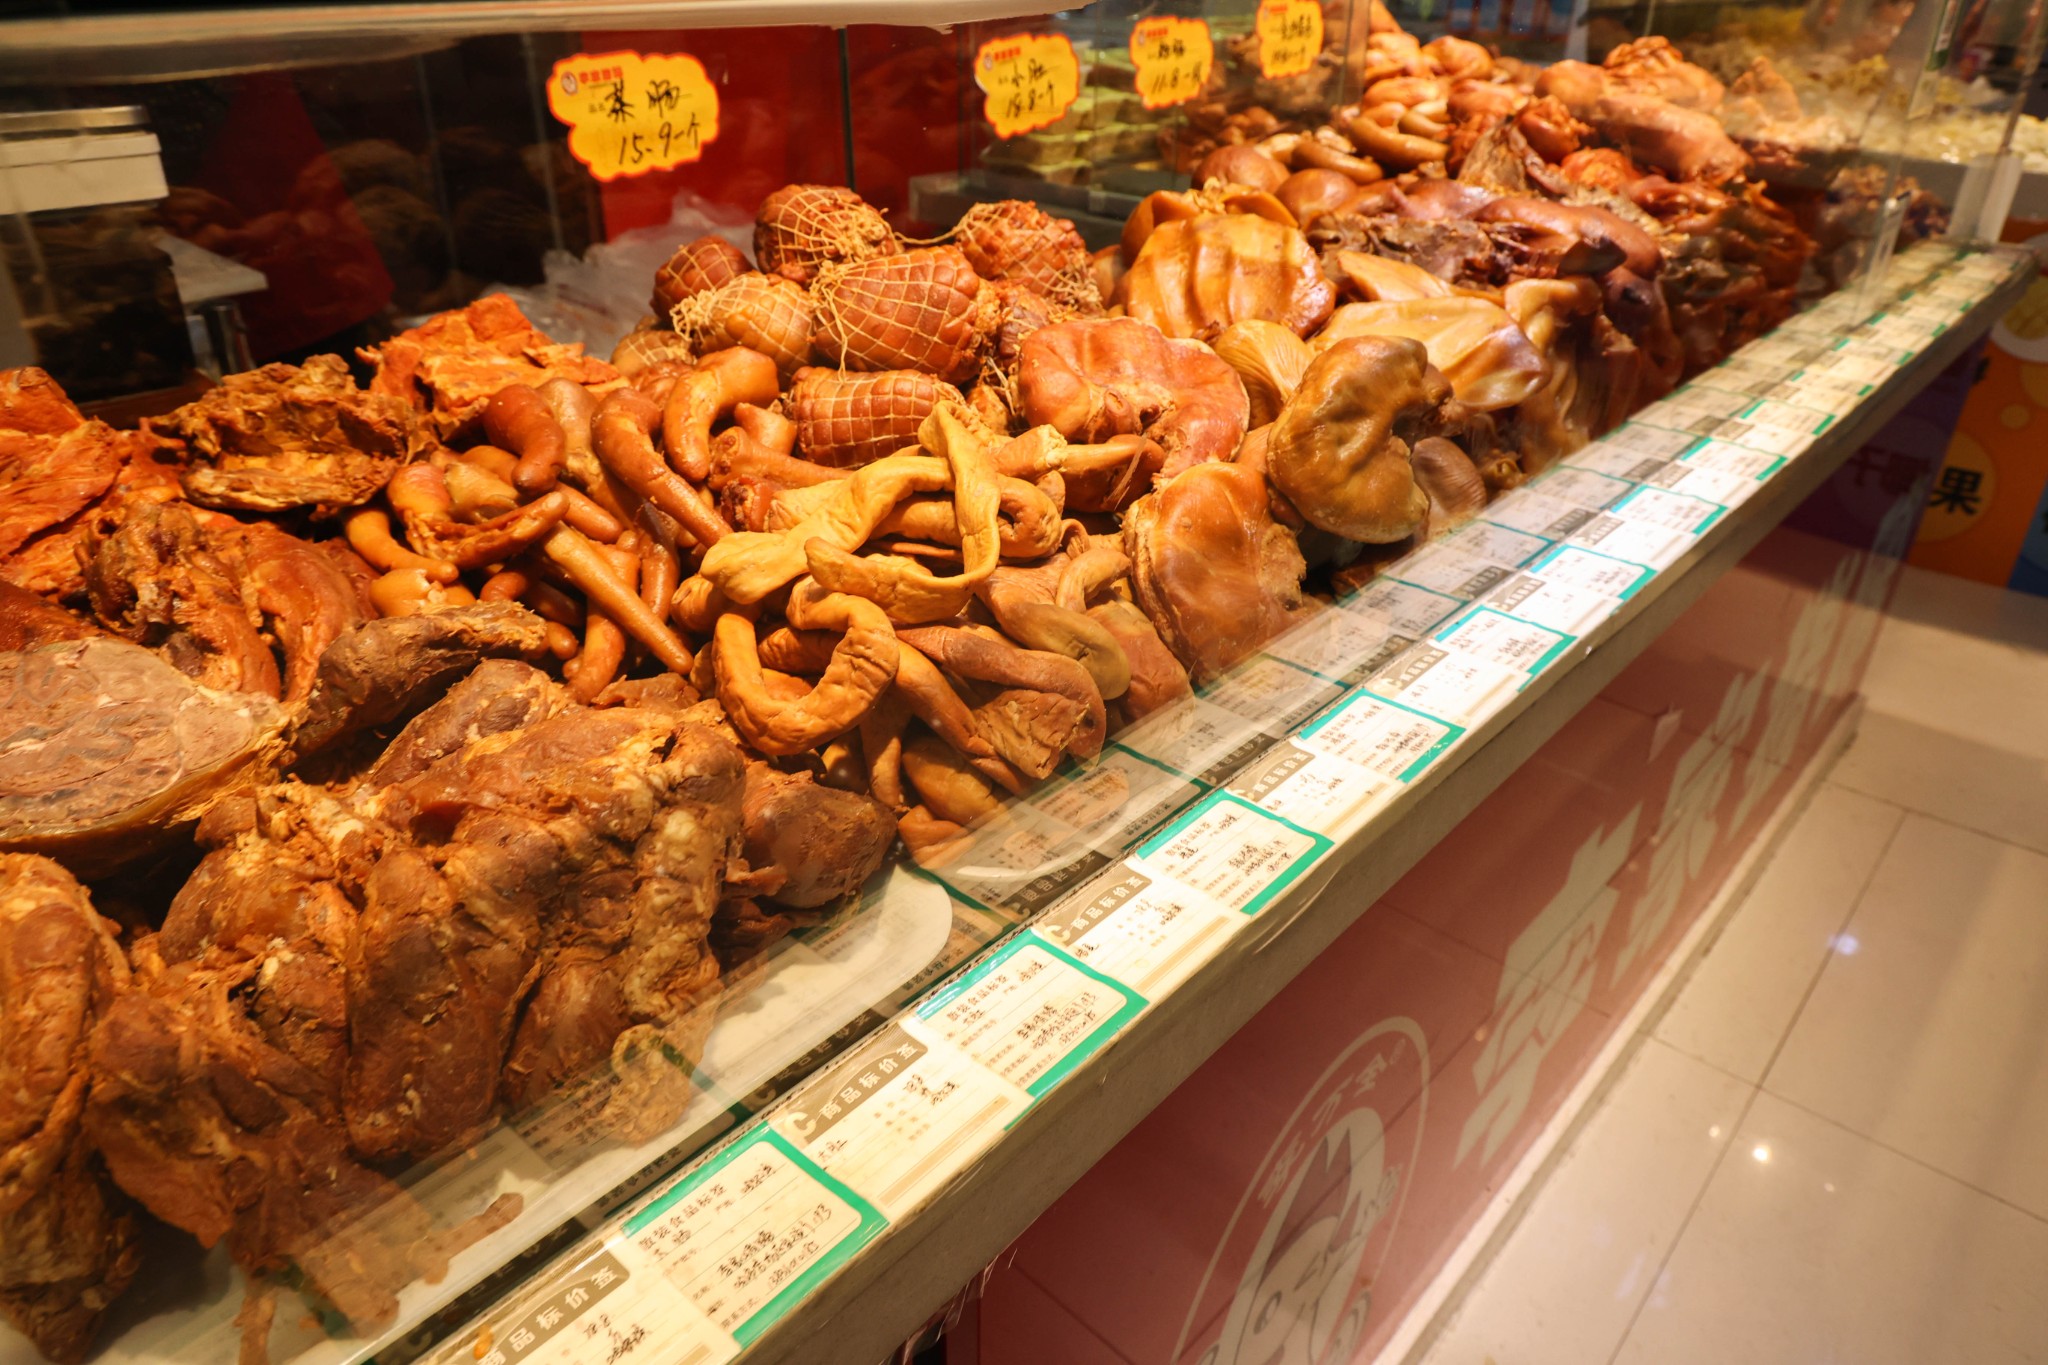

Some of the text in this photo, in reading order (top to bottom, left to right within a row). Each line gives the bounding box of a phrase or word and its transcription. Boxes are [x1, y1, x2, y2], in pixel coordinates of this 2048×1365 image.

[1928, 465, 1985, 516] 果
[1074, 875, 1143, 930] 商品标价签
[822, 1043, 918, 1120] 商品标价签
